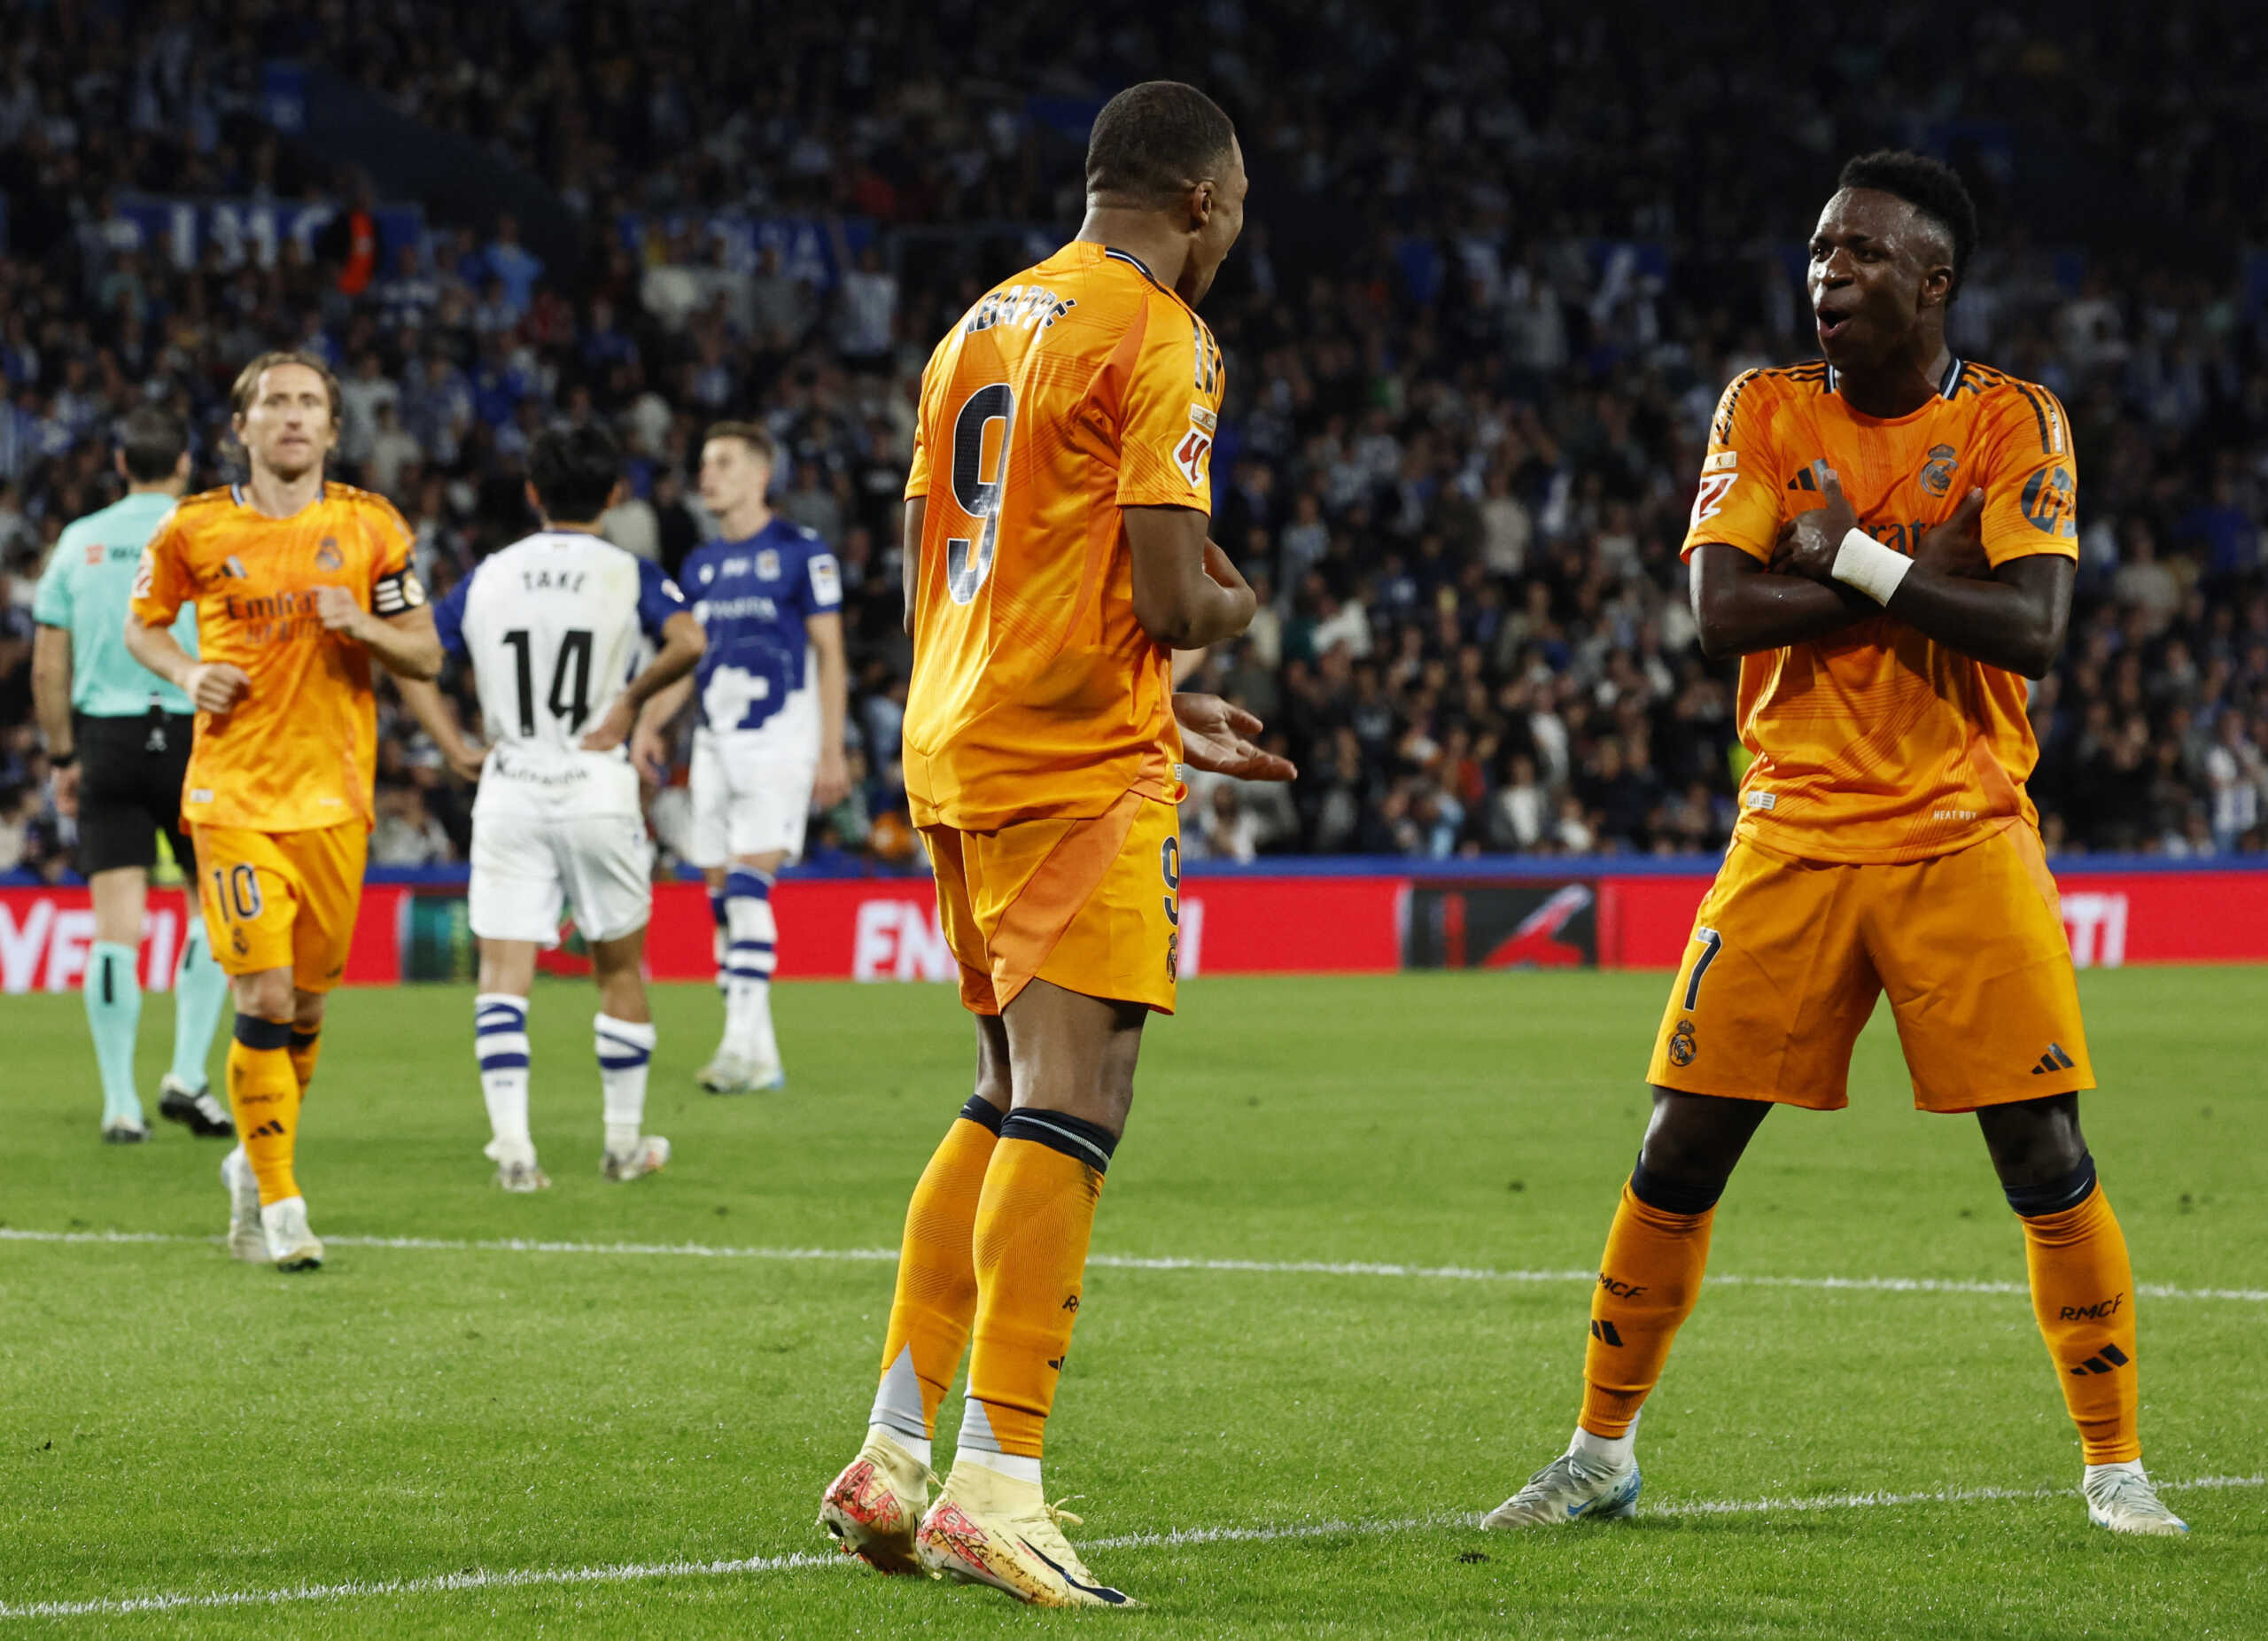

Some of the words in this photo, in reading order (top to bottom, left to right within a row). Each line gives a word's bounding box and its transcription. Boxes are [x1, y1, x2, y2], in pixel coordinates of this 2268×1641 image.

[947, 382, 1017, 605] 9
[501, 629, 593, 737] 14
[214, 862, 263, 924] 10
[1161, 836, 1180, 927] 9
[1683, 926, 1723, 1012] 7
[1598, 1272, 1649, 1299] MCF
[2060, 1293, 2124, 1320] RMCF
